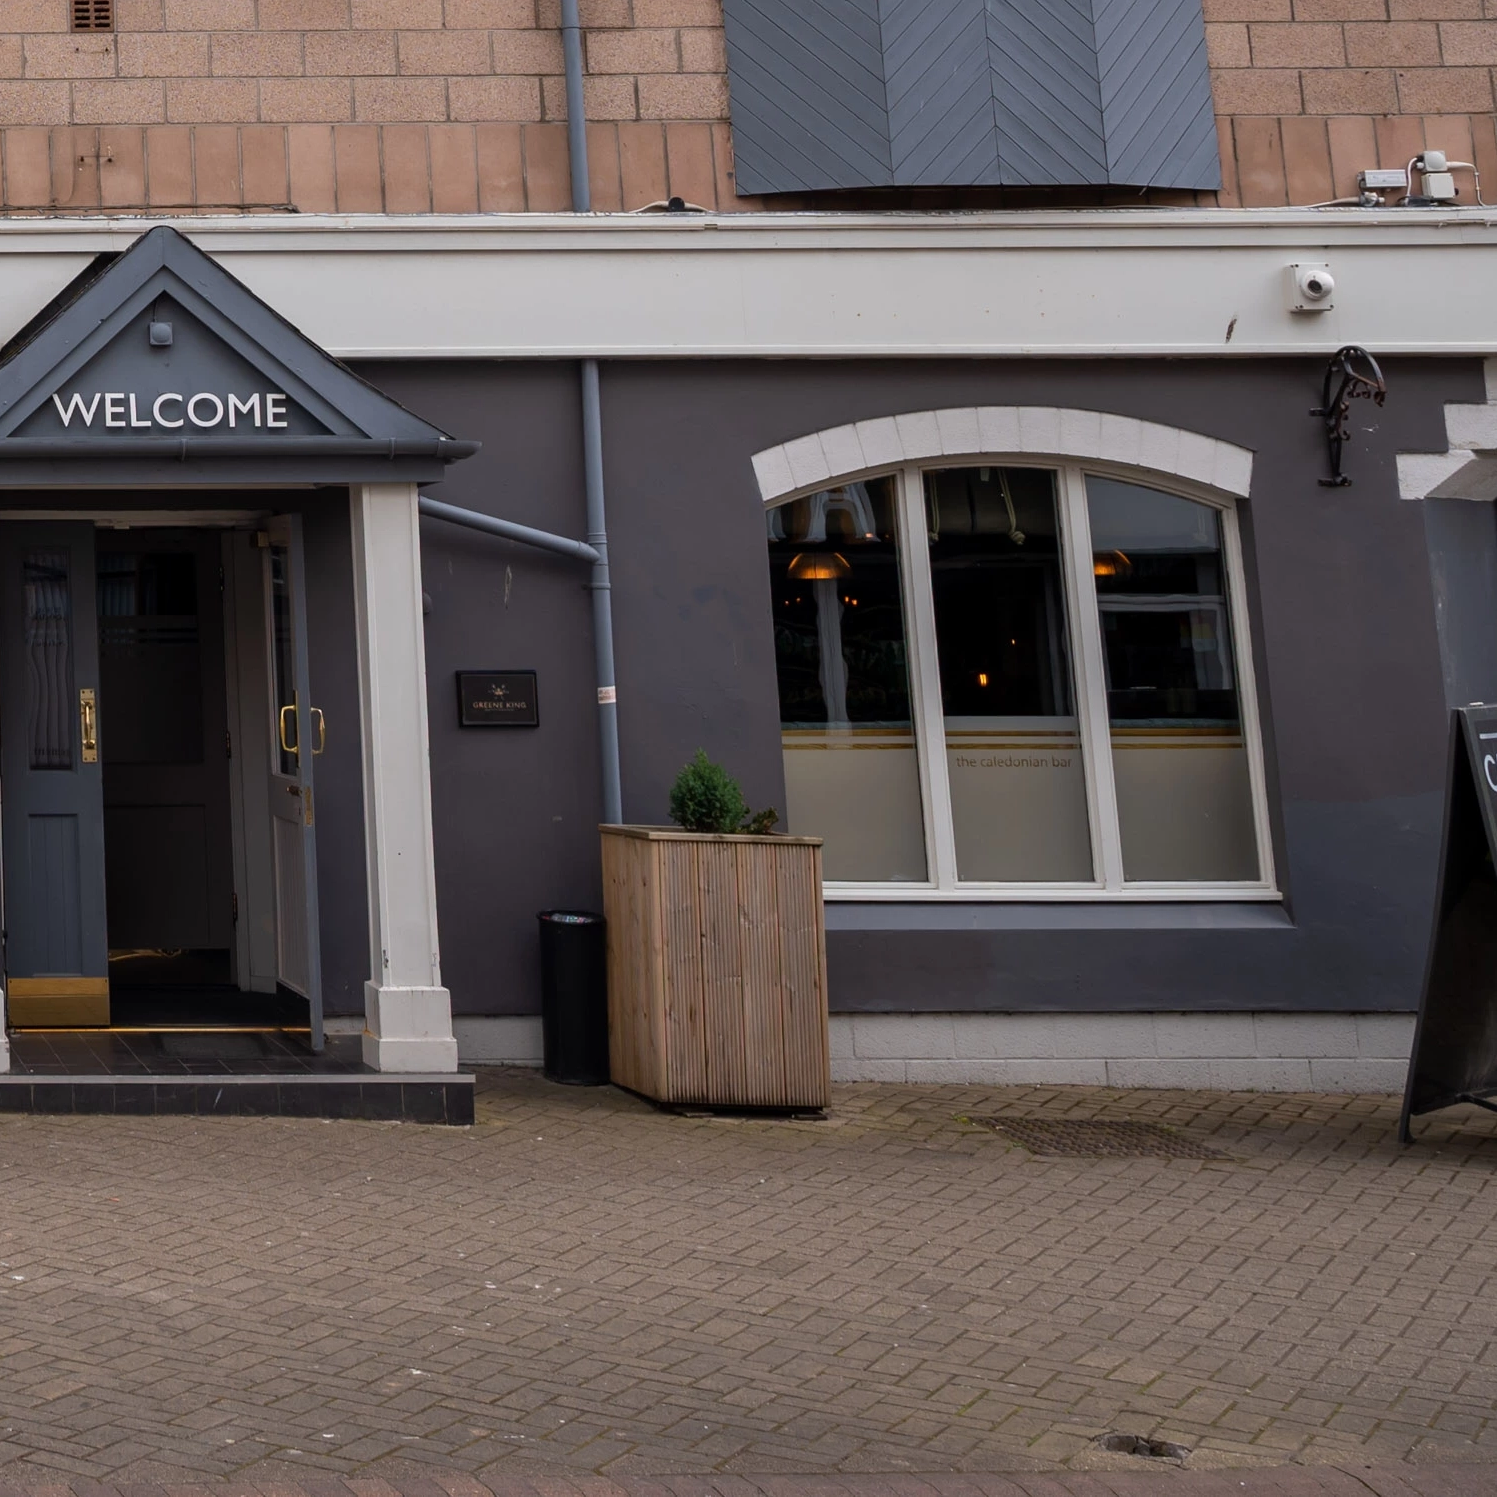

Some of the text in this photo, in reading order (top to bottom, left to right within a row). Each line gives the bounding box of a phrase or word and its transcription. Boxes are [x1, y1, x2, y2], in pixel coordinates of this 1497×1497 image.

[52, 392, 288, 428] WELCOME
[472, 701, 503, 709] GREENE
[506, 701, 527, 709] KING
[956, 755, 1072, 768] the caledonian bar
